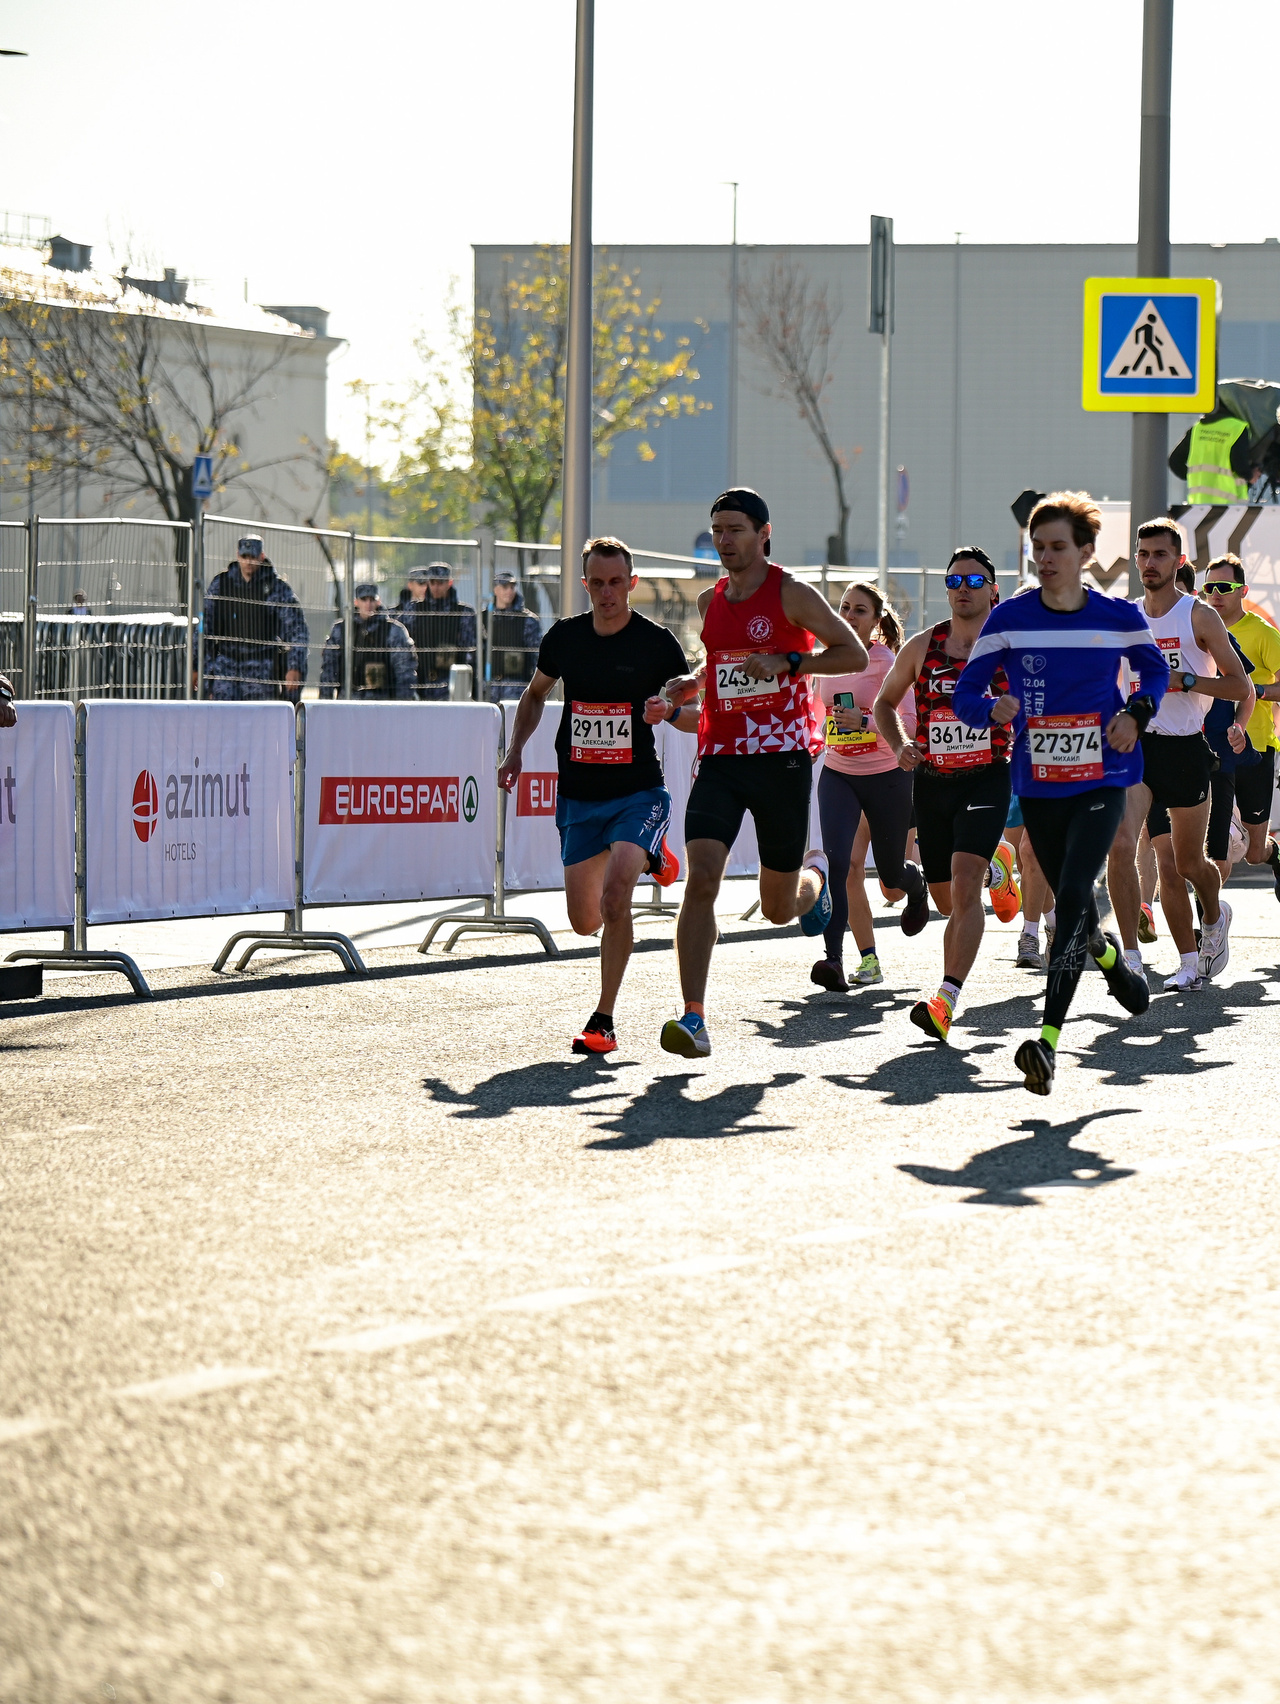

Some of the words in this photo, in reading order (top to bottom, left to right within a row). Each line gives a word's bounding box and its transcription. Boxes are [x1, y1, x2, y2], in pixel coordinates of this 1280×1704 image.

[719, 669, 774, 688] 243
[1023, 678, 1045, 688] 12.04
[738, 687, 756, 695] ДЕНИС
[929, 680, 993, 698] KEA
[1035, 692, 1044, 718] ПЕР
[573, 719, 629, 738] 29114
[932, 726, 988, 744] 36142
[946, 743, 974, 751] ДМИТРИЙ
[1033, 732, 1099, 753] 27374
[166, 756, 250, 820] azimut
[530, 780, 557, 808] EU
[336, 784, 457, 816] EUROSPAR
[165, 842, 196, 861] HOTELS
